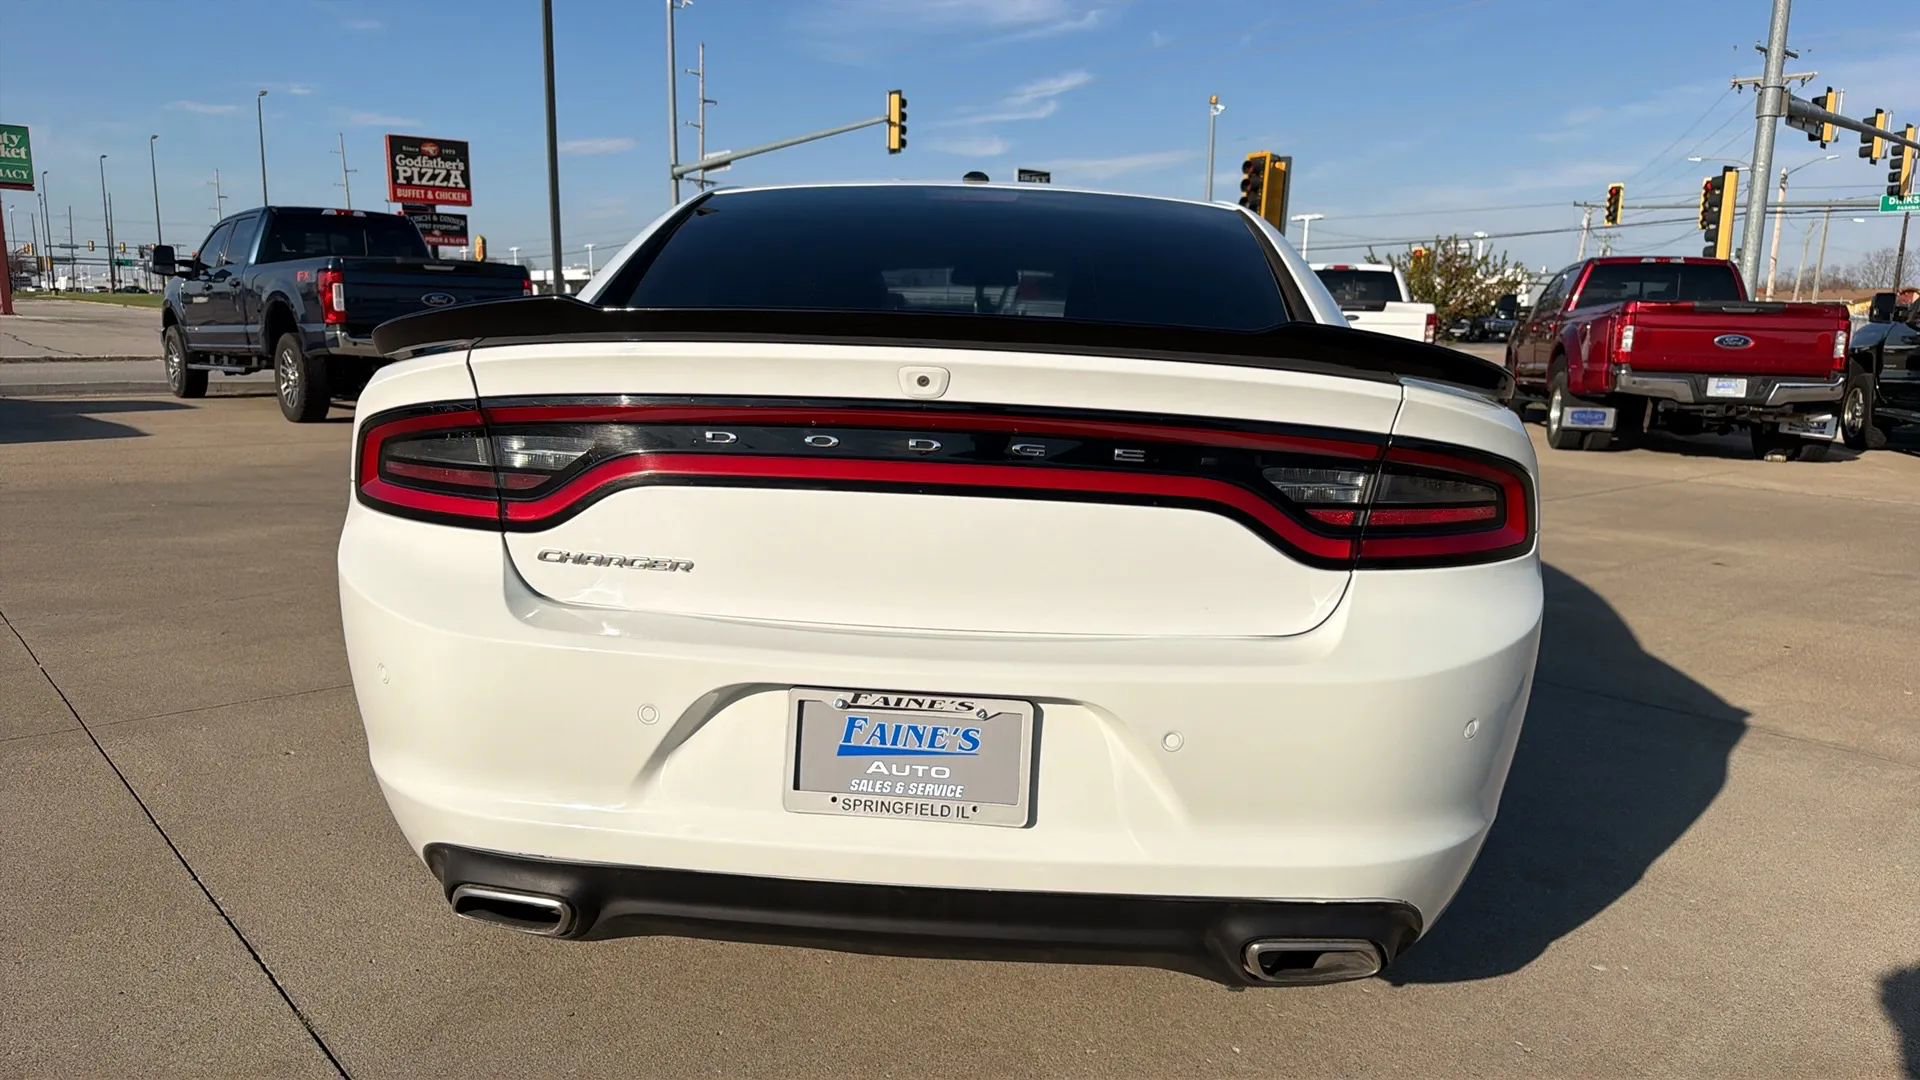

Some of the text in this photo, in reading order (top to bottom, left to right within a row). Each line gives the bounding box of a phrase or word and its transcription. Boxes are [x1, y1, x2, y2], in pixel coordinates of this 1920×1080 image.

[395, 154, 465, 171] Godfather's
[396, 166, 466, 188] PIZZA
[397, 188, 467, 202] BUFFET & CHICKEN
[705, 431, 1146, 462] DODGE
[537, 549, 695, 573] CHARGER
[850, 692, 976, 713] FAINE'S
[841, 715, 982, 753] FAINE'S
[866, 760, 951, 779] AUTO
[849, 779, 965, 799] SALES & SERVICE
[841, 797, 971, 819] SPRINGFIELD IL
